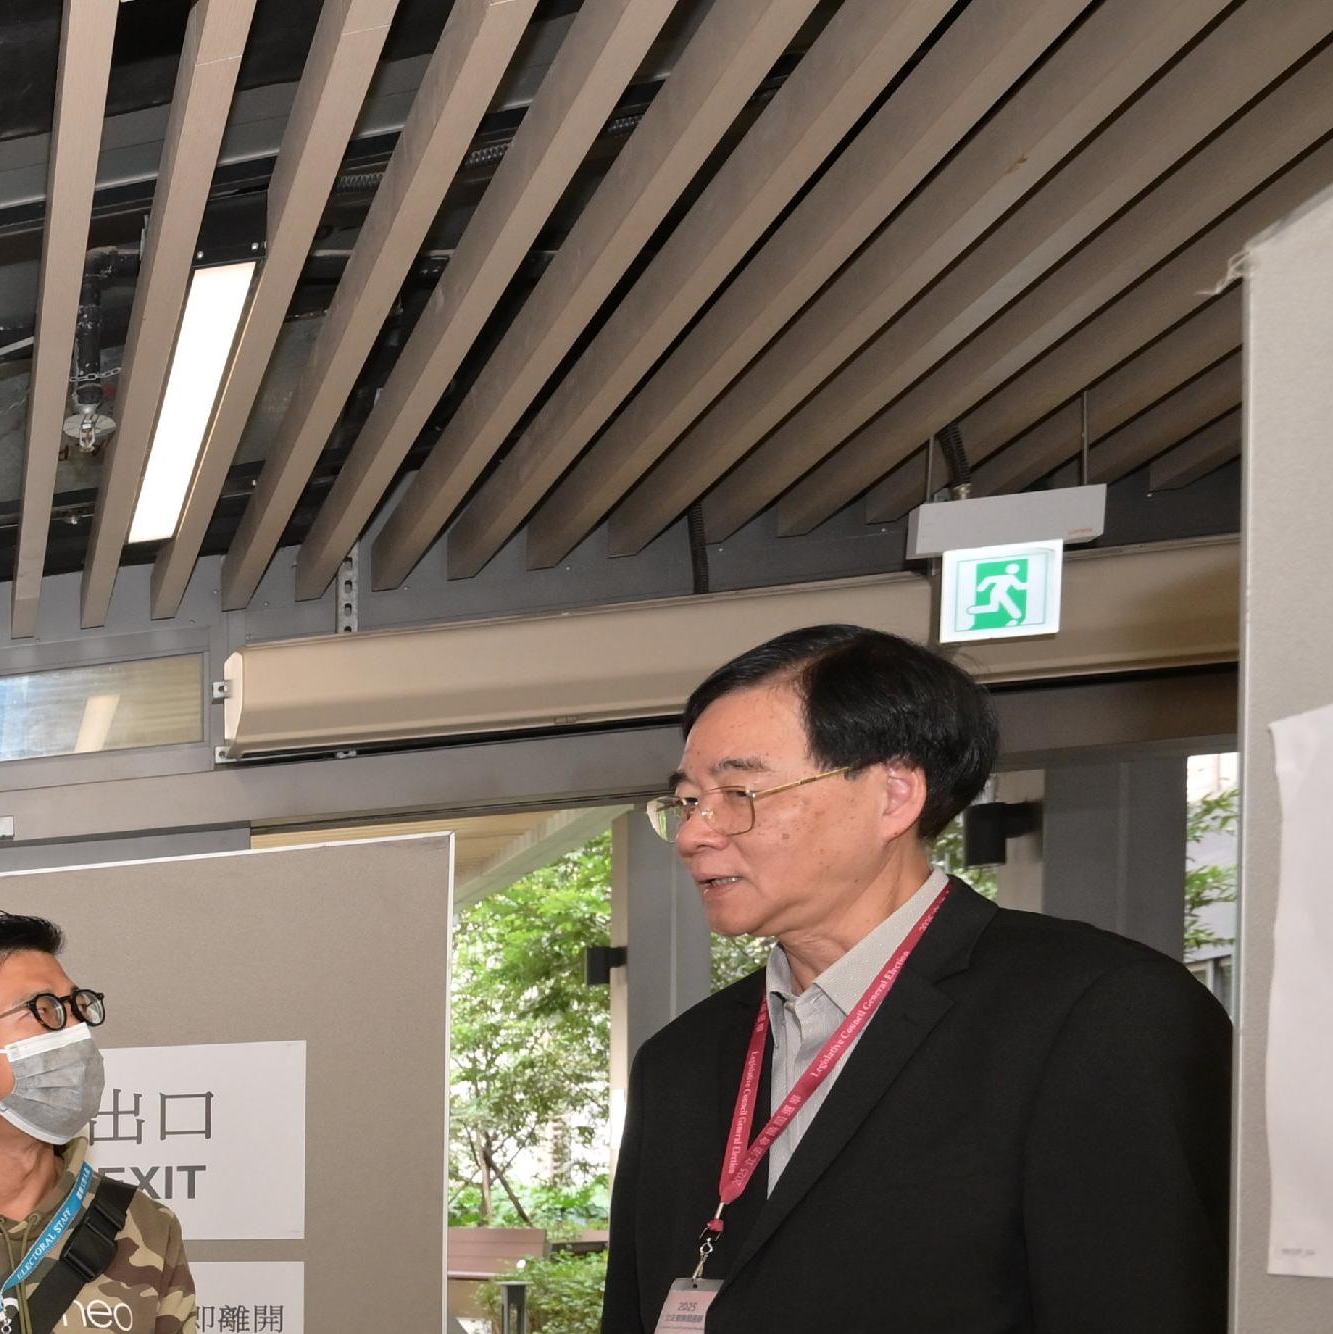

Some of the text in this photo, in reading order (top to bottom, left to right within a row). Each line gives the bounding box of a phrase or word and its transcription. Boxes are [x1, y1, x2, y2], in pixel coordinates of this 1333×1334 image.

[810, 951, 910, 1077] Legislative Council General Election
[89, 1088, 214, 1146] 出口
[16, 1208, 71, 1281] ELECTORAL STAFF
[62, 1300, 132, 1331] neo
[677, 1302, 697, 1311] 2025
